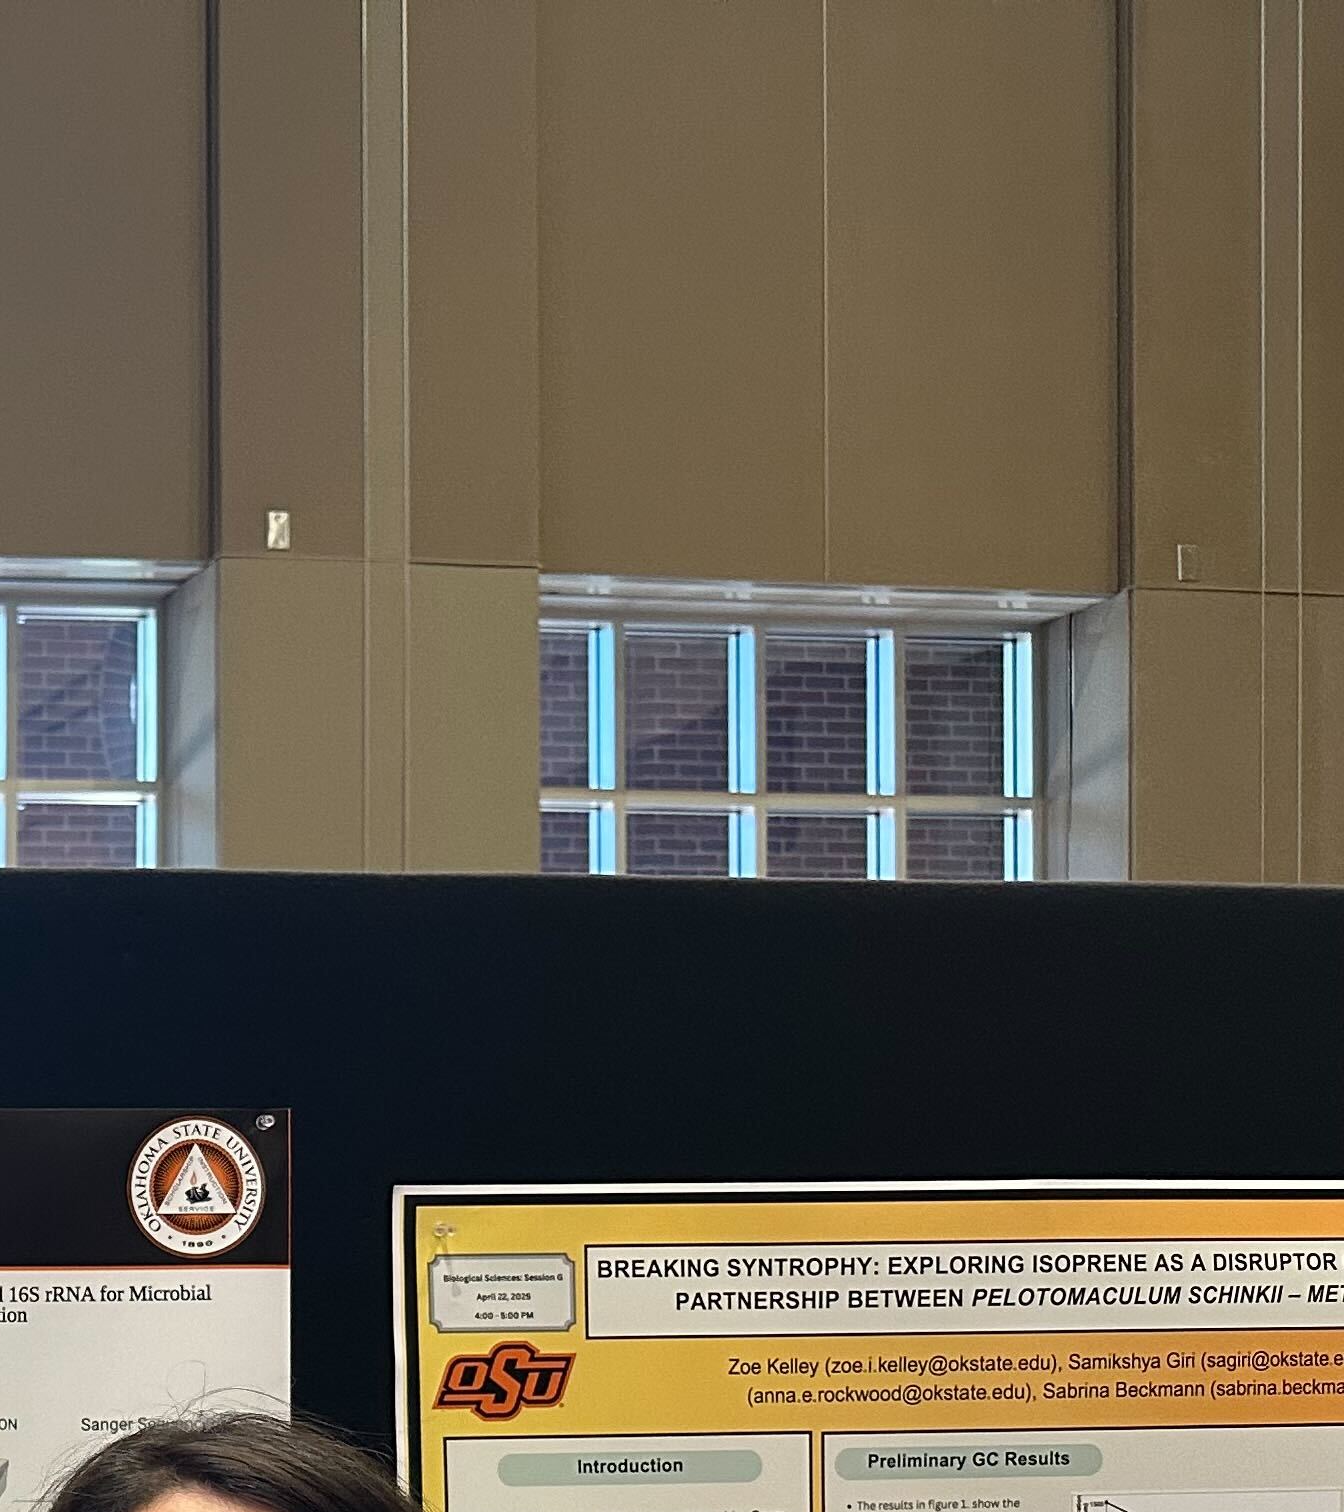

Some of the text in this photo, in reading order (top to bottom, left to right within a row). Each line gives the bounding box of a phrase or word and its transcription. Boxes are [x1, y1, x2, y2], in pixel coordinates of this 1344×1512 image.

[597, 1252, 1338, 1279] BREAKING SYNTROPHY: EXPLORING ISOPRENE AS A DISRUPTOR
[442, 1273, 483, 1284] Biological
[484, 1273, 523, 1283] Sciences:
[524, 1273, 555, 1283] Session
[9, 1286, 40, 1303] 16S
[44, 1285, 97, 1303] rRNA
[99, 1284, 125, 1302] for
[128, 1283, 213, 1302] Microbial
[476, 1292, 496, 1302] April
[497, 1292, 510, 1302] 22,
[676, 1284, 1284, 1311] PARTNERSHIP BETWEEN PELOTOMACULUM SCHINKII
[727, 1358, 762, 1376] Zoe
[767, 1357, 820, 1379] Kelley
[825, 1353, 1063, 1378] (zoe.i.kelley@okstate.edu),
[1068, 1352, 1161, 1374] Samikshya
[1166, 1351, 1196, 1369] Giri
[431, 1340, 578, 1422] OSU
[577, 1457, 683, 1474] Introduction
[868, 1450, 1070, 1471] Preliminary GC Results
